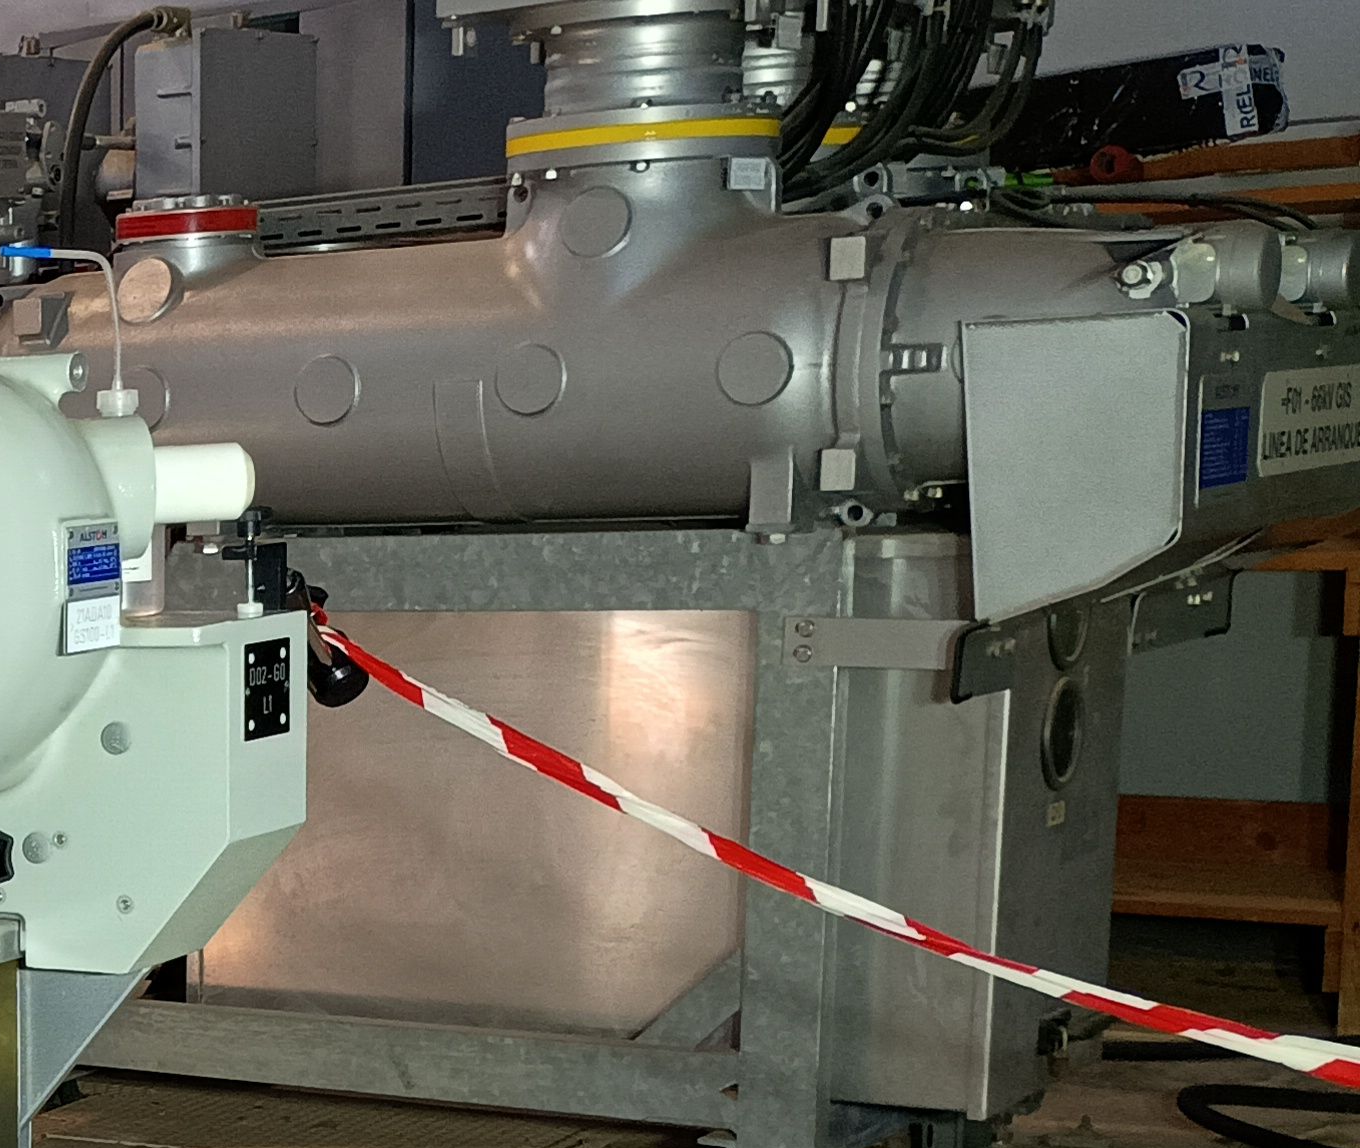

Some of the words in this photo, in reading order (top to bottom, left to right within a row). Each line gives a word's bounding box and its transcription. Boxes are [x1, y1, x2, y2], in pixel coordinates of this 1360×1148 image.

[1336, 381, 1352, 409] GIS
[1262, 429, 1292, 460] LINEA
[1294, 427, 1310, 456] DE
[80, 529, 108, 542] ALSTOM
[263, 694, 273, 714] L1
